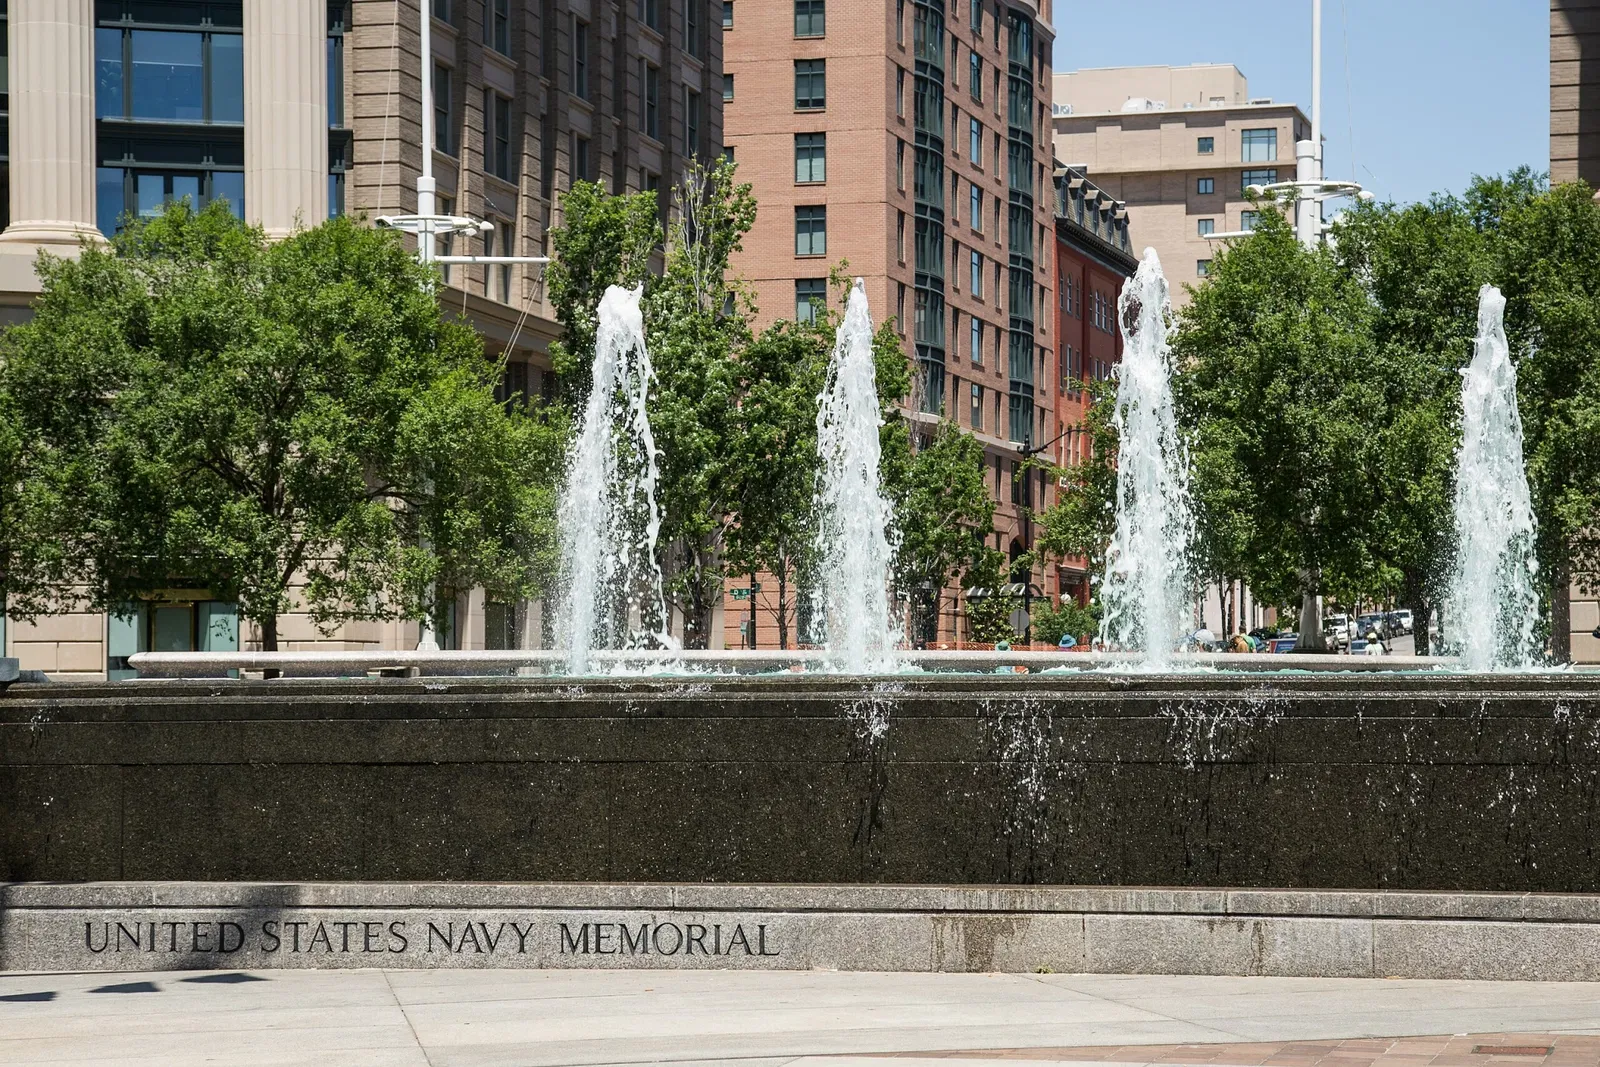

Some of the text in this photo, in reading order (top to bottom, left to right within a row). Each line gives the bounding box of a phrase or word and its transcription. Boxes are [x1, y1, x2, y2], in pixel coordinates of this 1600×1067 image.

[84, 920, 780, 956] UNITED STATES NAVY MEMORIAL
